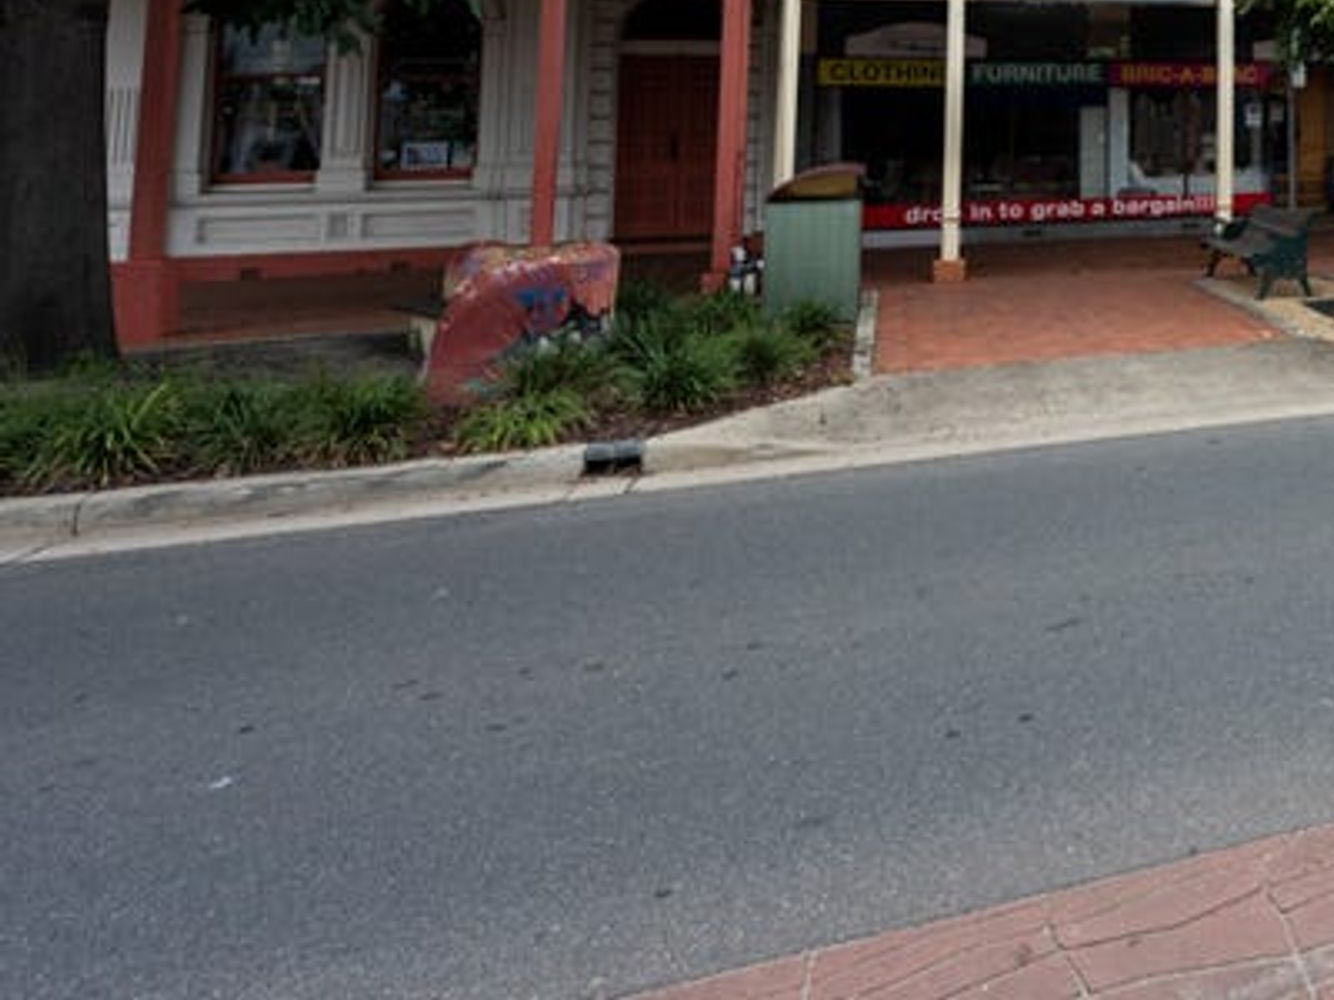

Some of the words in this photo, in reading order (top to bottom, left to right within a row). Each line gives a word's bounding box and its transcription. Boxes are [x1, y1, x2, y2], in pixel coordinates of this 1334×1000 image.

[829, 62, 946, 82] CLOTHIN
[970, 62, 1103, 84] FURNITURE
[905, 205, 952, 225] dro
[969, 202, 993, 221] in
[999, 201, 1024, 220] to
[1029, 199, 1085, 222] grab
[1091, 202, 1105, 217] a
